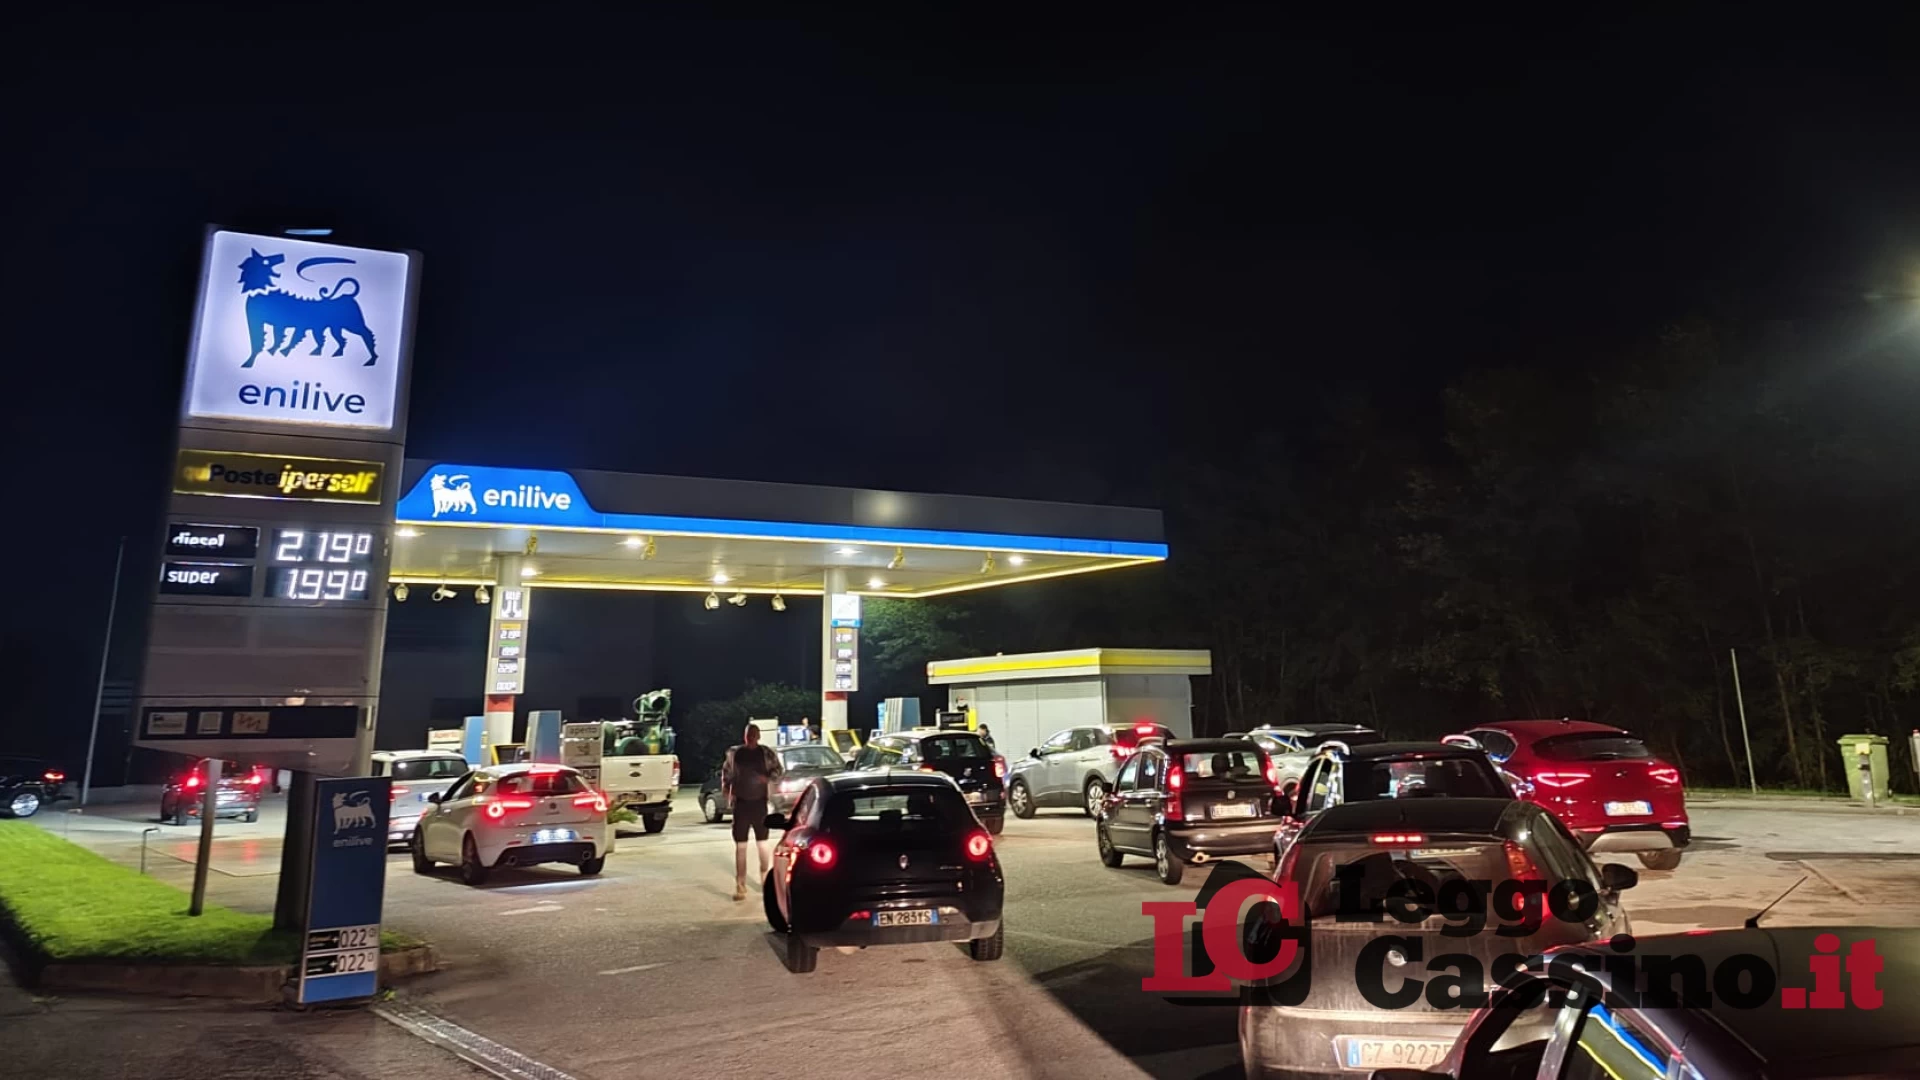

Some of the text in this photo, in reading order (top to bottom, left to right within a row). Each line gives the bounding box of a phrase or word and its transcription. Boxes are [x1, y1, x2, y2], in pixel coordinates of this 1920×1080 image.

[238, 380, 366, 415] enilive
[483, 485, 572, 511] enilive
[171, 532, 226, 549] diesel
[167, 569, 220, 586] super
[332, 835, 373, 848] enilive
